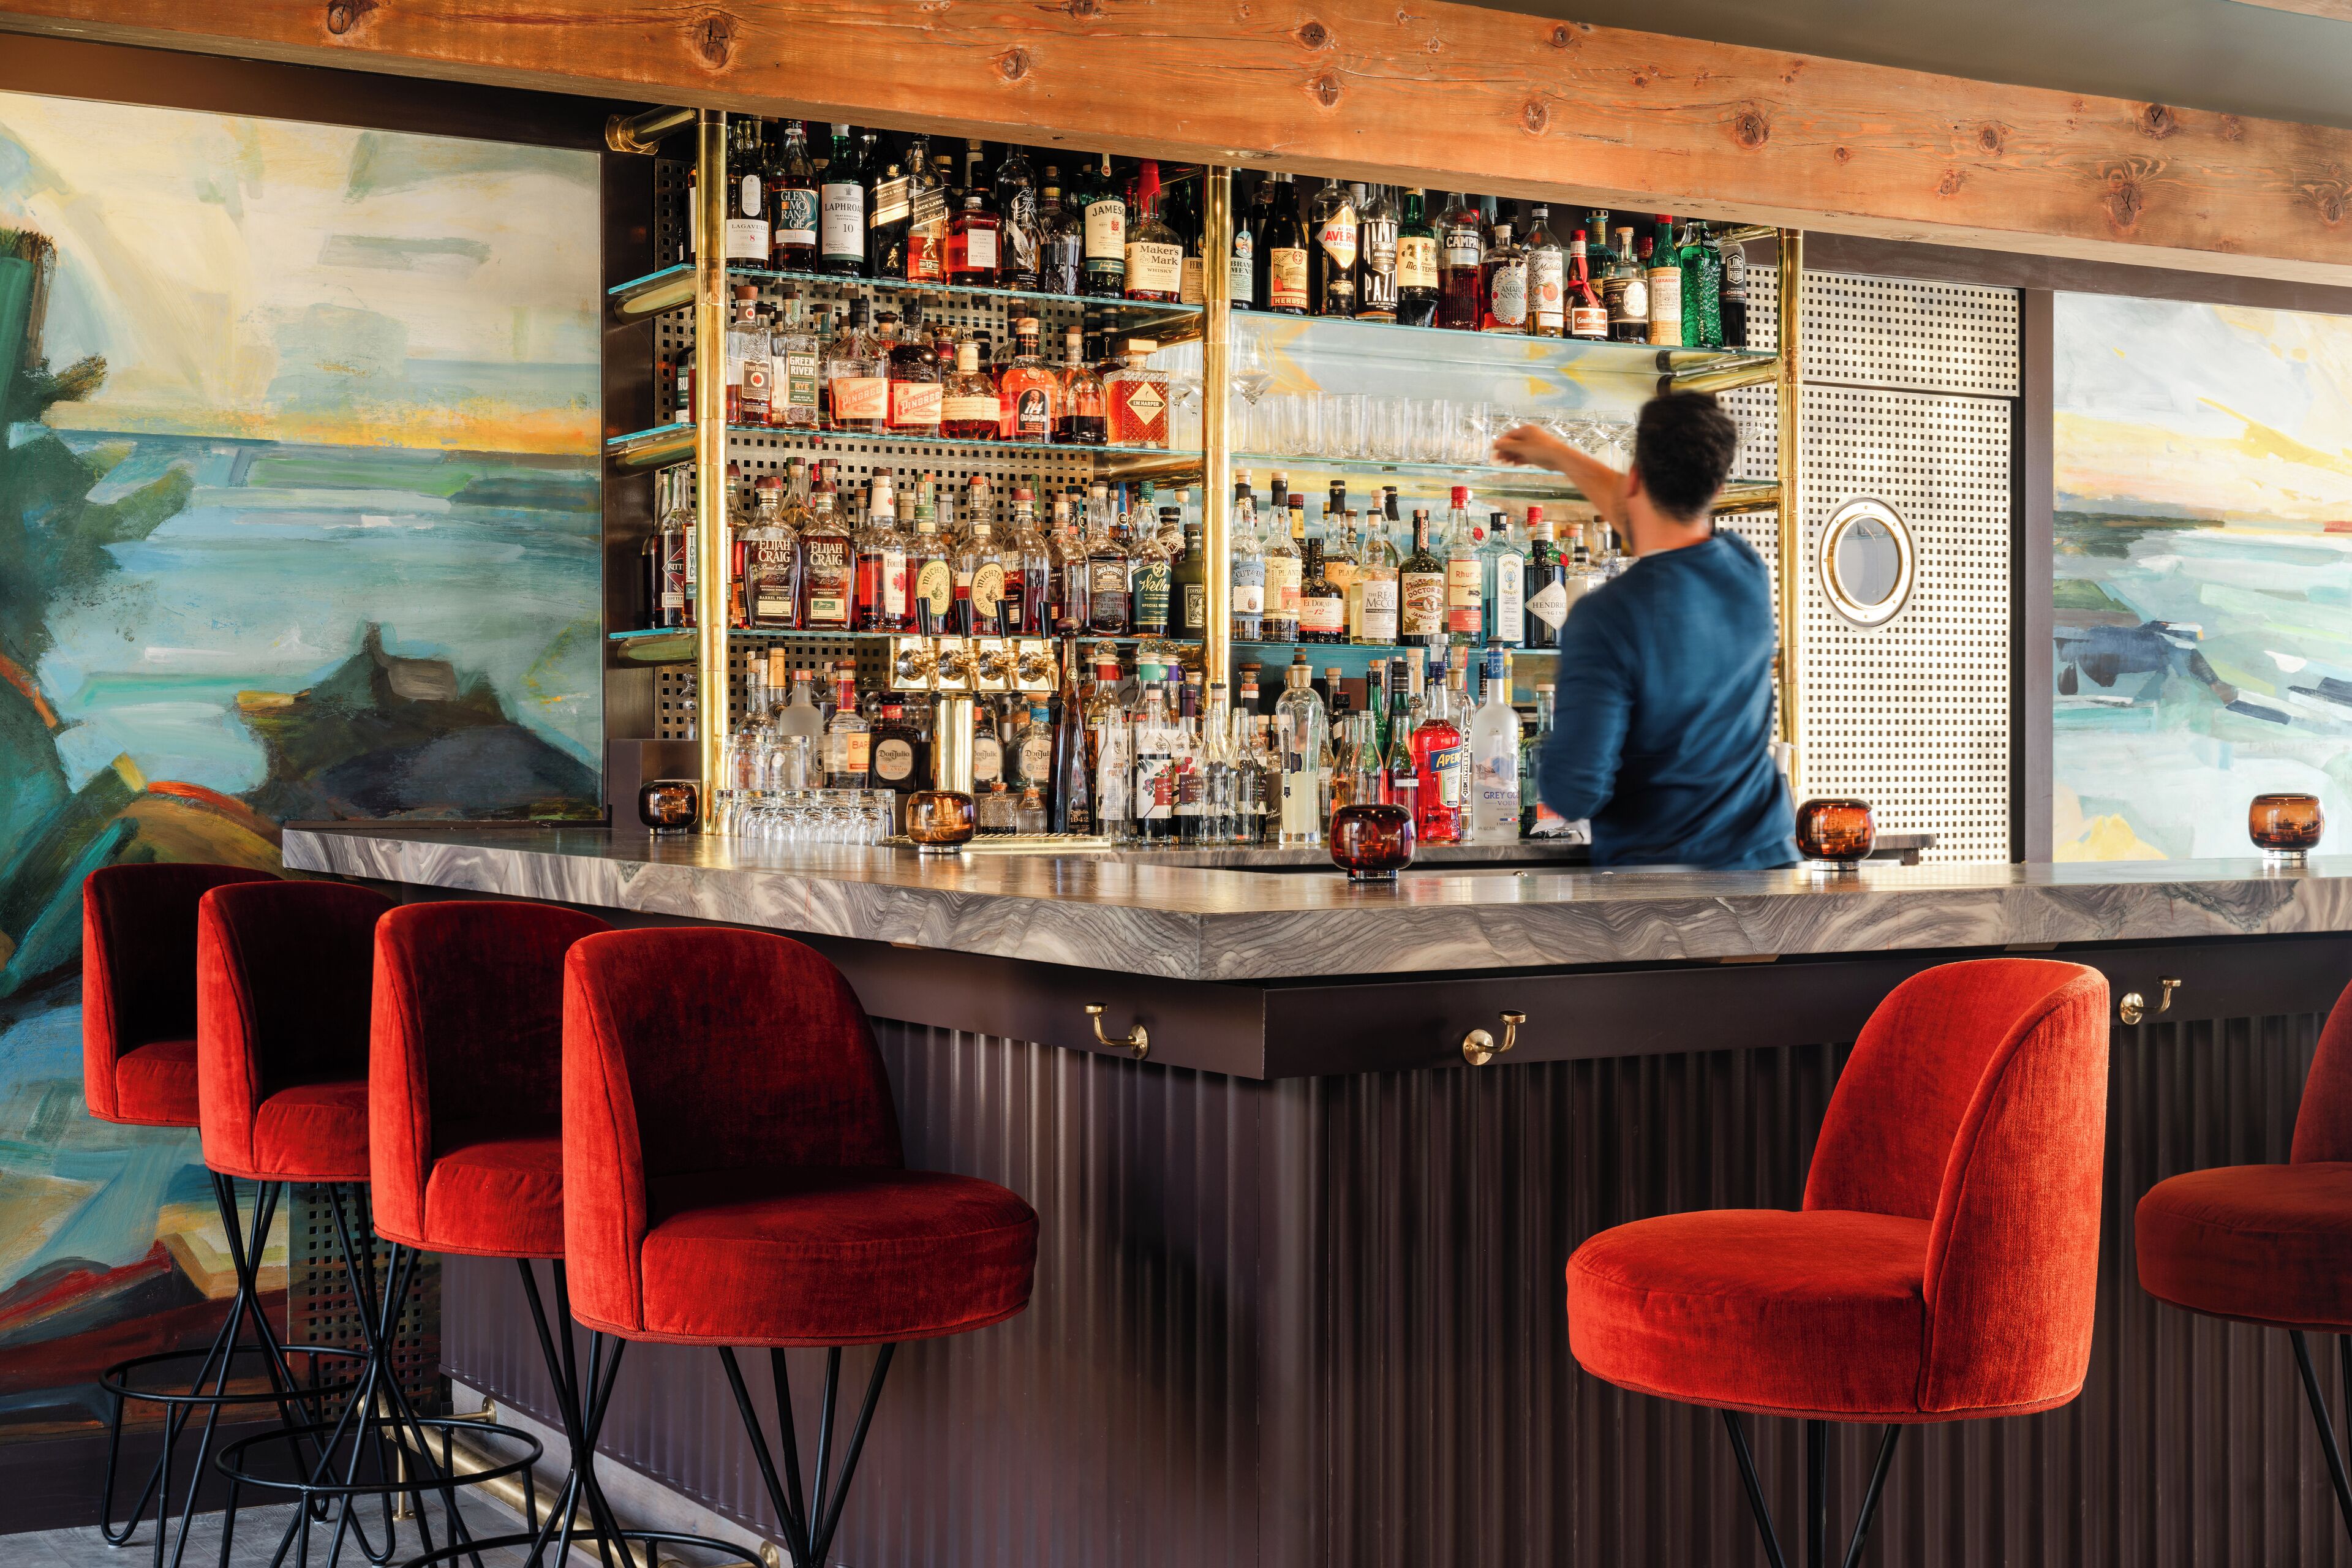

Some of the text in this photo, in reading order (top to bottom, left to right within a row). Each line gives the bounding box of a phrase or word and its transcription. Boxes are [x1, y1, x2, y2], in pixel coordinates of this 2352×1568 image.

[780, 191, 806, 201] GLEN
[790, 201, 807, 210] MO
[911, 198, 945, 213] BLACK LABEL
[789, 219, 805, 229] GIE
[843, 223, 854, 233] 10
[749, 234, 755, 243] 8
[1140, 245, 1179, 256] Maker's
[1152, 256, 1178, 266] Mark
[1730, 257, 1742, 268] LONG
[1538, 262, 1562, 272] Mathilde
[1730, 271, 1742, 281] ROAD
[790, 356, 815, 366] GREEN
[790, 366, 814, 376] RIVER
[1024, 401, 1044, 414] 114
[758, 538, 791, 552] ELIJAH
[810, 541, 843, 556] ELIJAH
[758, 550, 790, 564] CRAIG
[810, 552, 843, 567] CRAIG
[776, 565, 789, 573] Proof
[812, 567, 831, 576] Straight
[1096, 565, 1123, 576] JACK DANIEL'S
[1235, 570, 1250, 578] CUT
[1139, 574, 1170, 592] Weller
[1377, 591, 1395, 600] REAL
[1408, 587, 1435, 599] DOCTOR
[1411, 611, 1436, 620] JAMAICA
